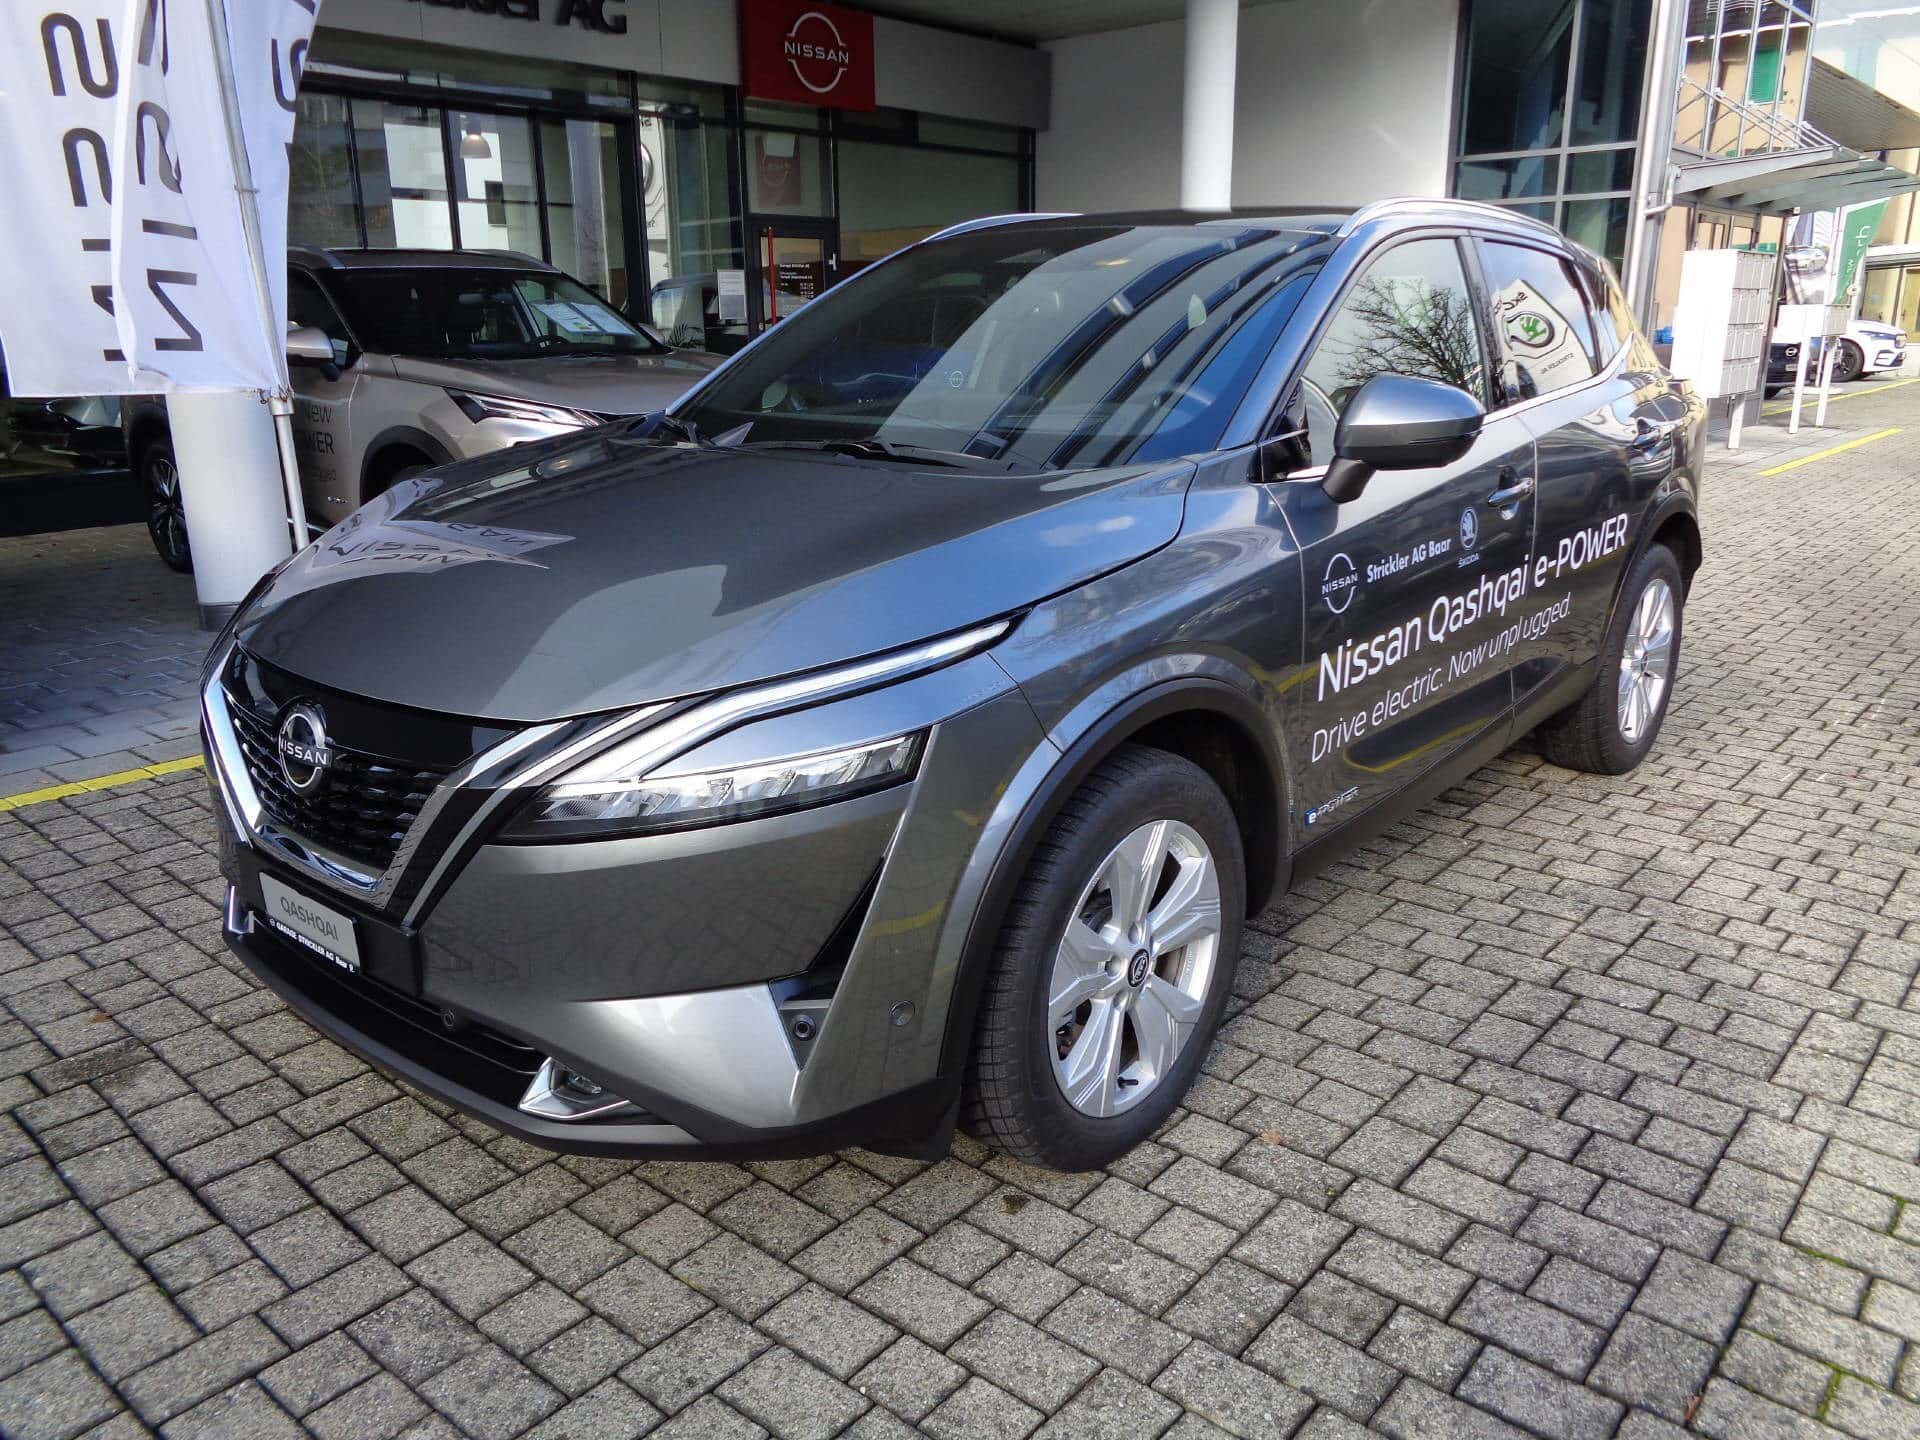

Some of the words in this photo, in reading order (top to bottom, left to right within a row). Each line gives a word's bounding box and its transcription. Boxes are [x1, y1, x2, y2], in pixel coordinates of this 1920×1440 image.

[784, 40, 849, 65] NISSAN
[1366, 553, 1409, 583] Strickler
[1412, 544, 1427, 564] AG
[1429, 538, 1451, 560] Baar
[1321, 572, 1359, 595] NISSAN
[1318, 617, 1422, 701] Nissan
[1428, 554, 1529, 644] Qashqai
[1534, 512, 1629, 588] e-POWER
[1311, 711, 1367, 763] Drive
[1371, 666, 1444, 726] electric.
[1448, 645, 1488, 683] Now
[1488, 591, 1571, 656] unplugged.
[279, 896, 339, 942] QASHQAI
